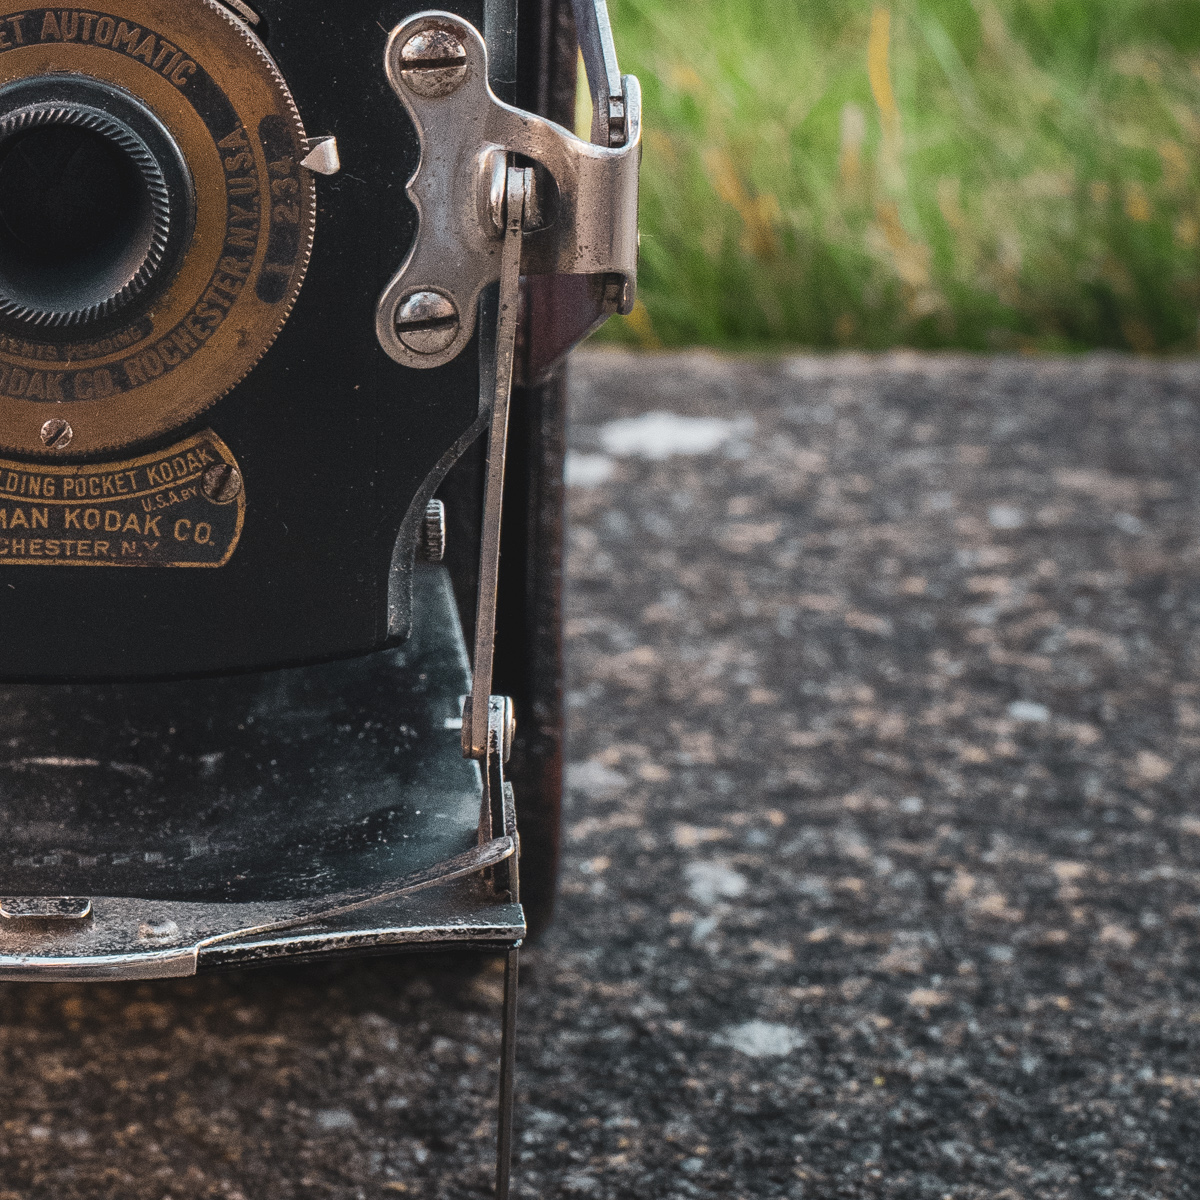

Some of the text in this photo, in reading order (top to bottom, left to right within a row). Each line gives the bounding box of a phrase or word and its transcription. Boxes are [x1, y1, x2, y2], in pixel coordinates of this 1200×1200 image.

[40, 10, 198, 87] AUTOMATIC
[269, 154, 295, 175] 4
[271, 177, 299, 196] 3
[272, 202, 300, 224] 2
[63, 467, 138, 498] POCKET
[146, 447, 215, 485] KODAK
[181, 486, 198, 501] BY
[64, 508, 163, 538] KODAK
[173, 519, 217, 547] CO.
